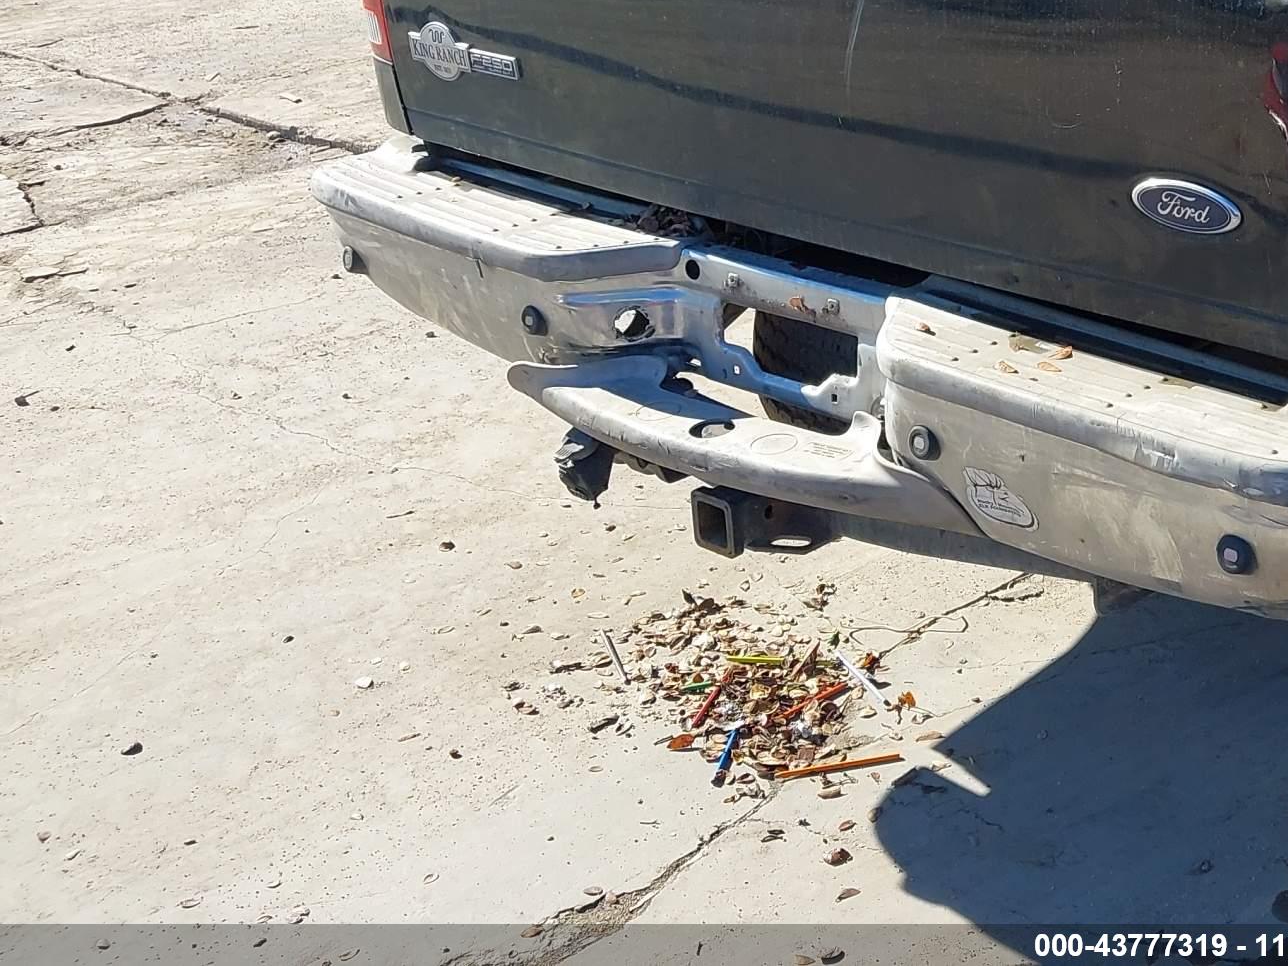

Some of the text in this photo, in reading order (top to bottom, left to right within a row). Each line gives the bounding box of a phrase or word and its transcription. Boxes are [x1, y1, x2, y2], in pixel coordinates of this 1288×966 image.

[411, 38, 467, 67] KING RANCH
[1157, 190, 1210, 223] Ford
